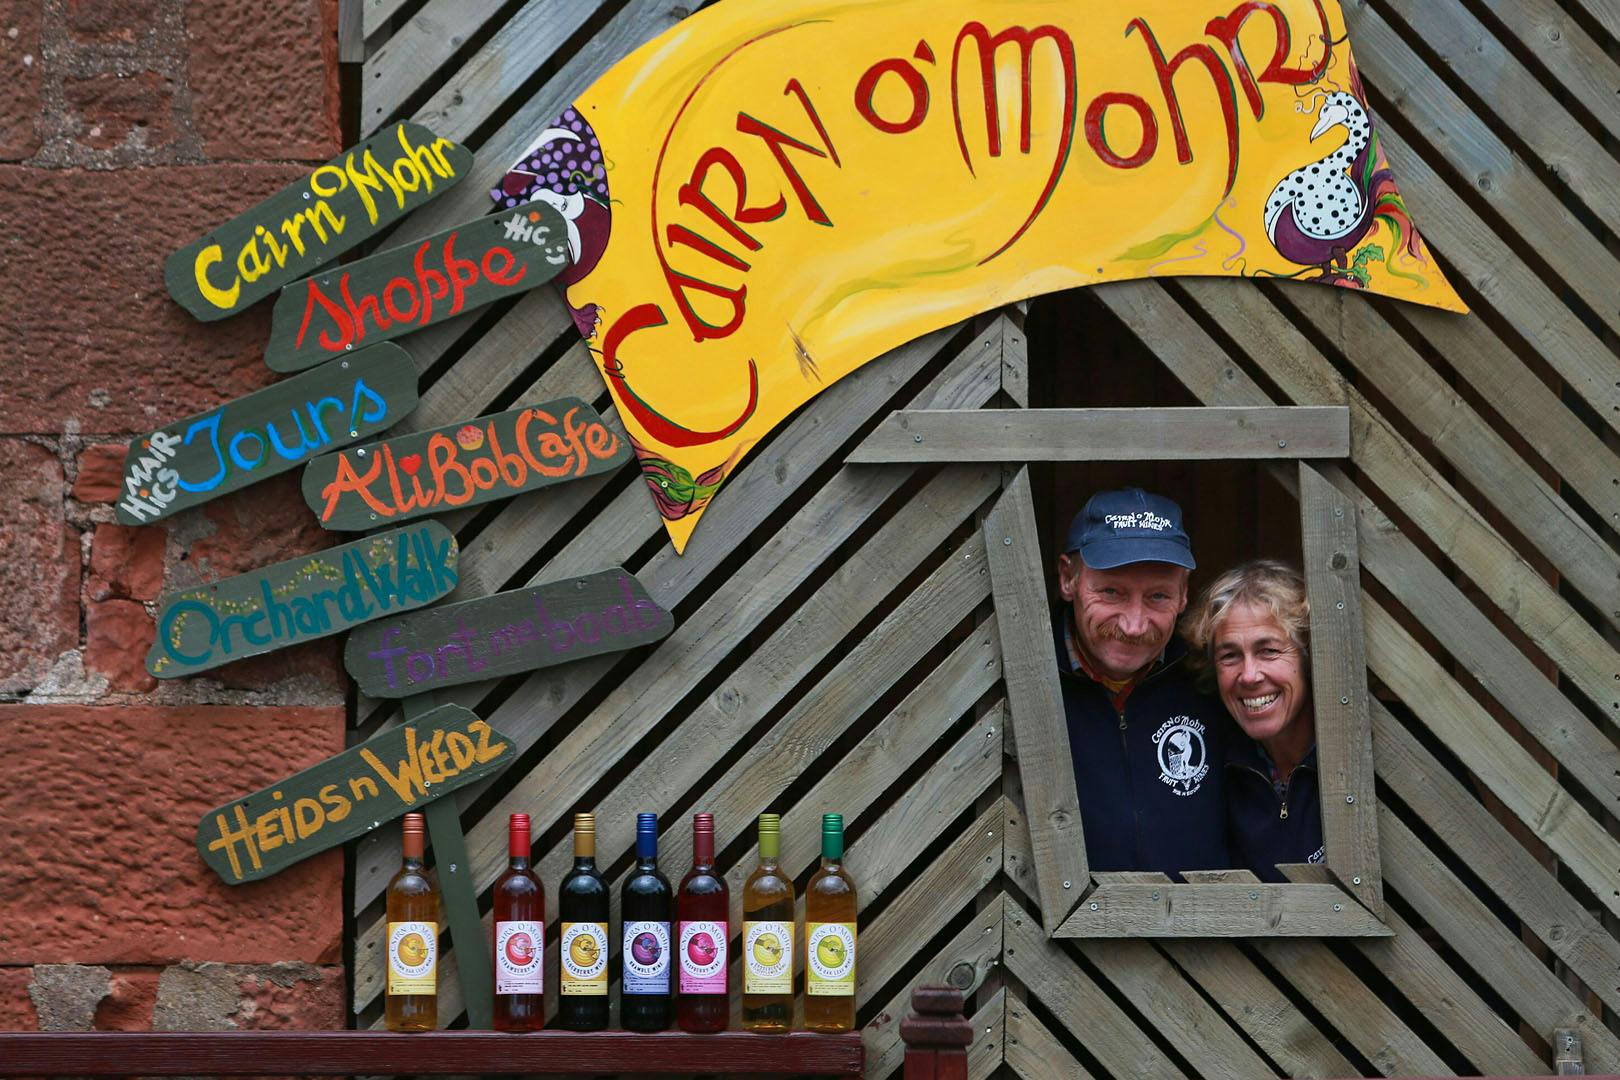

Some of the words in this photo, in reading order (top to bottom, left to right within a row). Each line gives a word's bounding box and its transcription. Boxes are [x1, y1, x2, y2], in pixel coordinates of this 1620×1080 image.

[194, 200, 346, 310] Cairn
[345, 124, 455, 226] Mohr
[296, 232, 528, 352] Shoppe
[178, 377, 388, 493] Tours
[1113, 520, 1137, 528] FRUIT
[368, 616, 488, 689] fort
[359, 720, 507, 806] WEEDZ
[349, 776, 380, 800] n
[1158, 772, 1178, 787] FRUIT
[501, 956, 530, 974] STRAWBERRY
[531, 957, 540, 969] WINE
[595, 959, 605, 970] WINE
[629, 960, 650, 974] BRAMBLE
[652, 962, 663, 972] WINE
[710, 960, 721, 970] WINE
